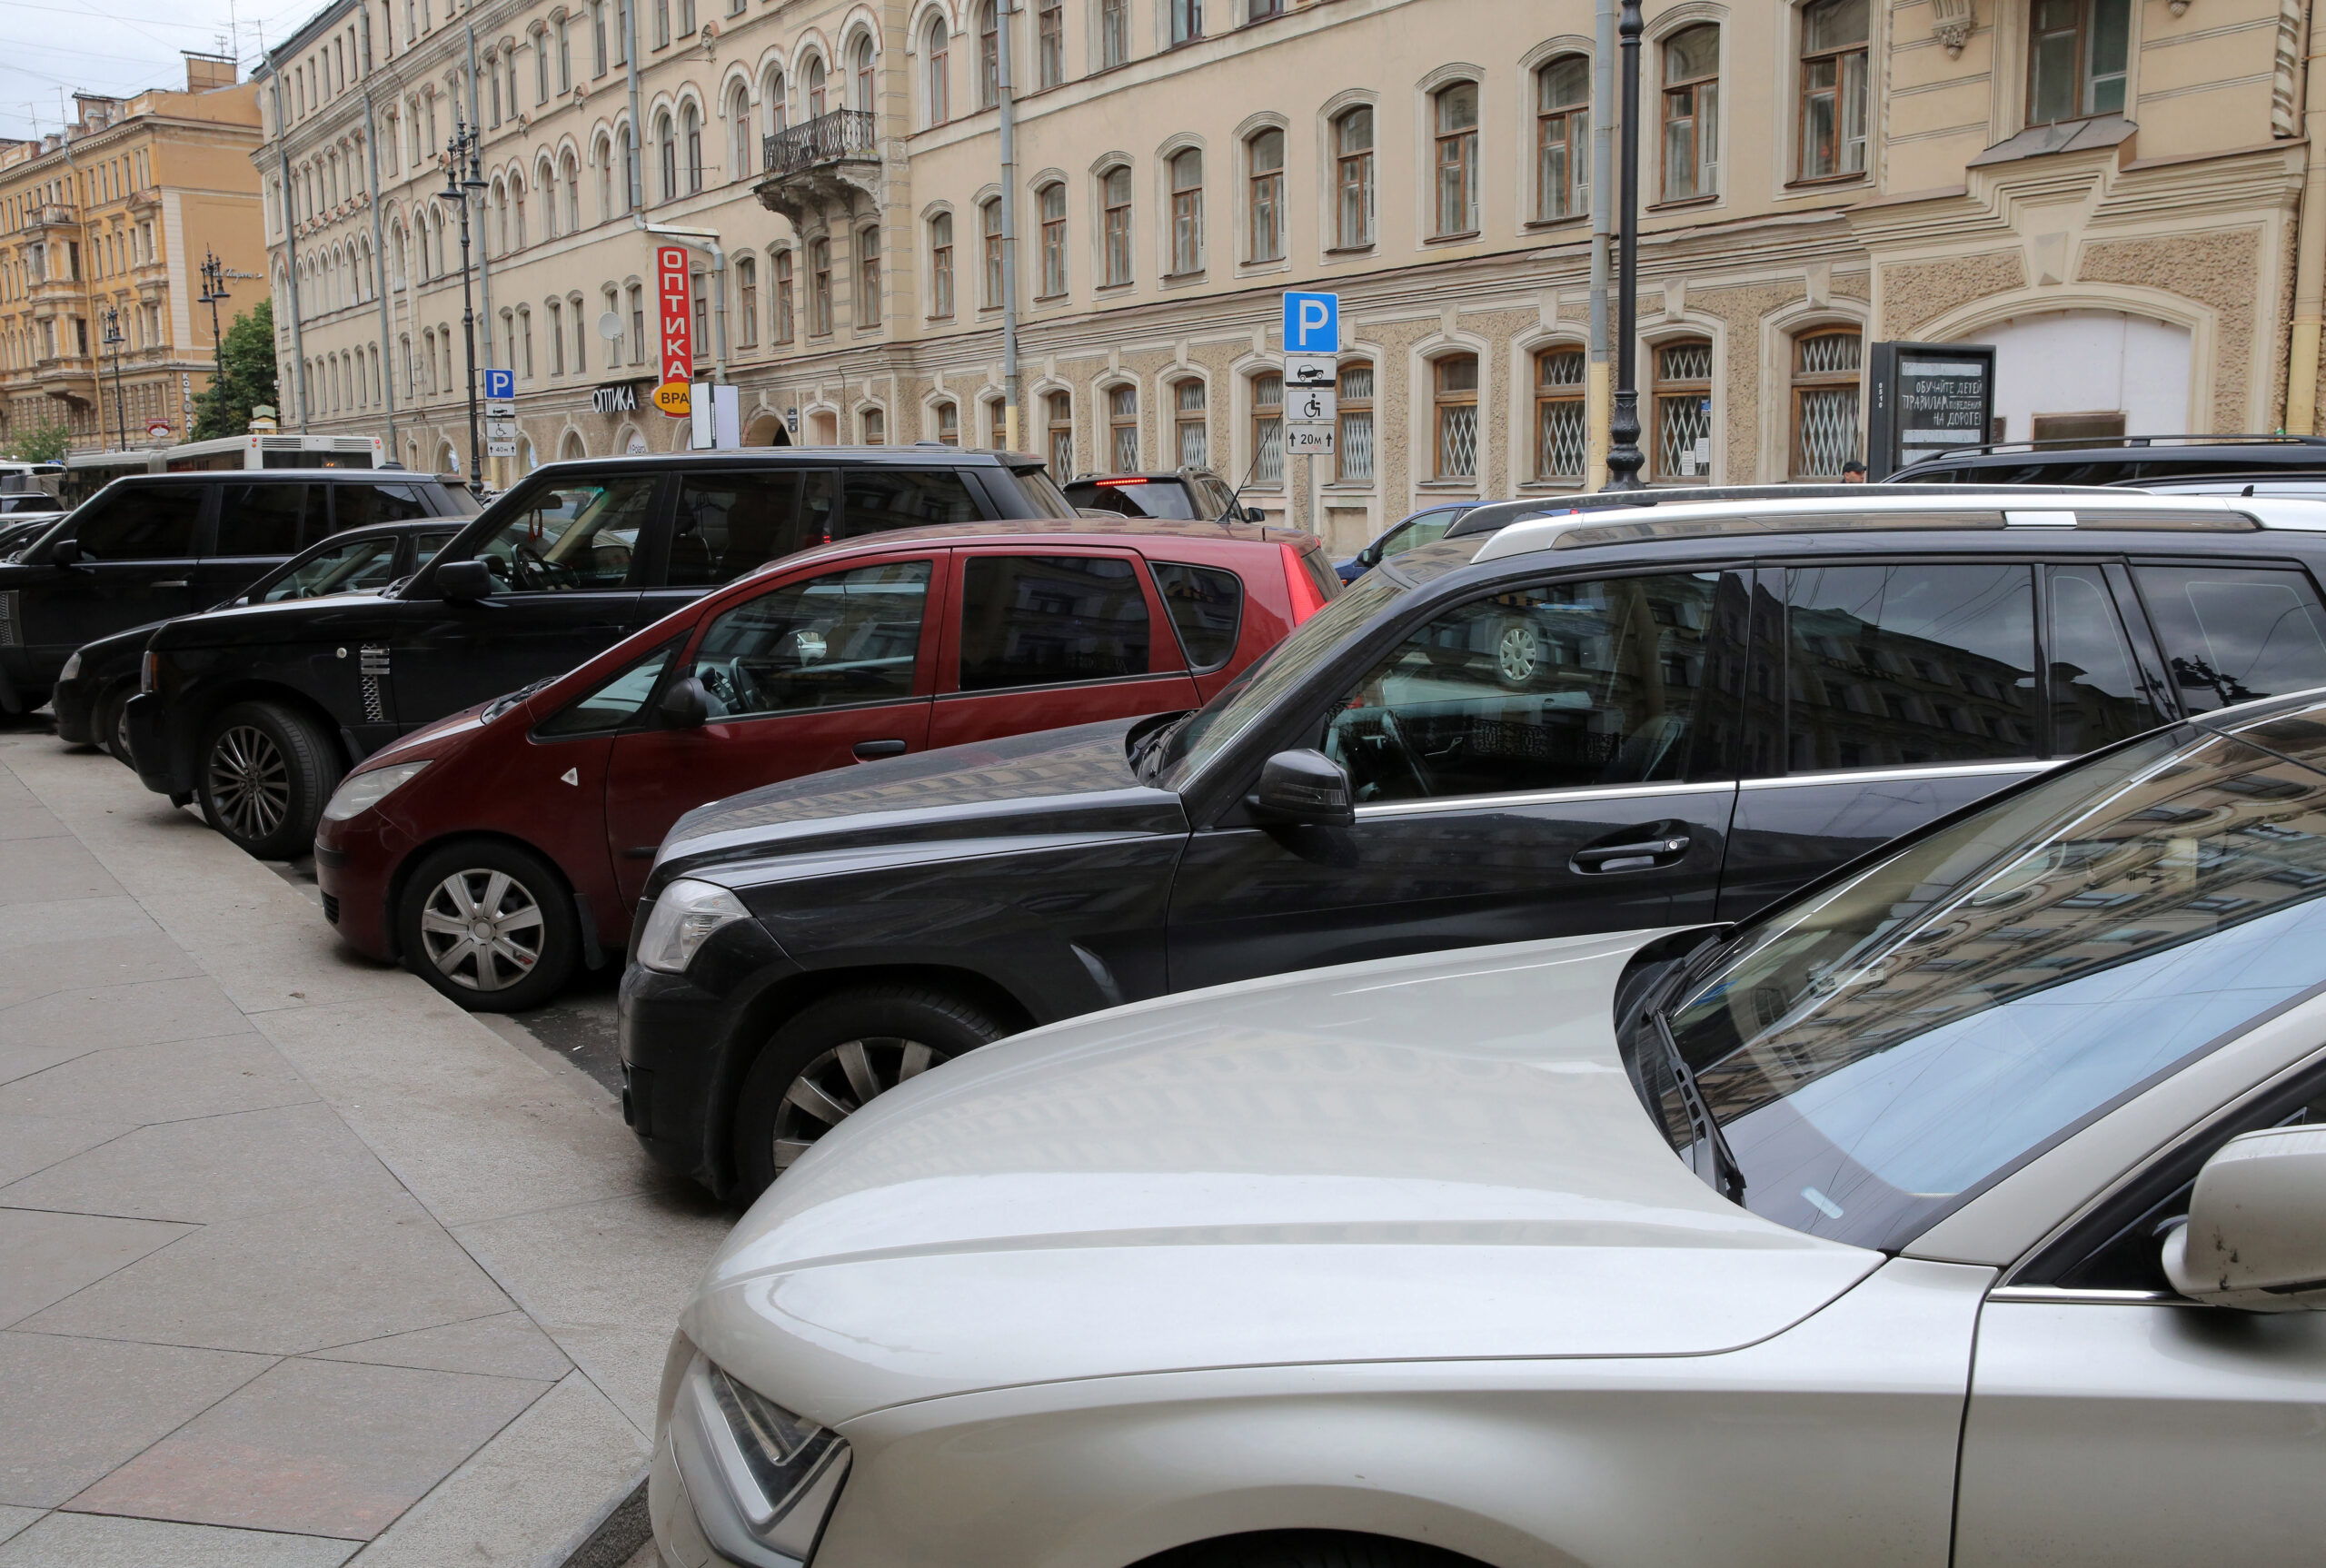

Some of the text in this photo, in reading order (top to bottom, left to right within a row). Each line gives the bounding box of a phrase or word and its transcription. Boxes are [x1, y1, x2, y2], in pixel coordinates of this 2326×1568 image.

[662, 251, 688, 378] ОПТИКА
[1299, 300, 1328, 345] P
[493, 372, 509, 396] P
[1916, 380, 1983, 394] ОБУЧАЙТЕ ДЕТЕЙ
[591, 385, 636, 414] ОПТИКА
[1902, 395, 1949, 411] ПРАВИЛАМ
[1933, 412, 1944, 426] НА
